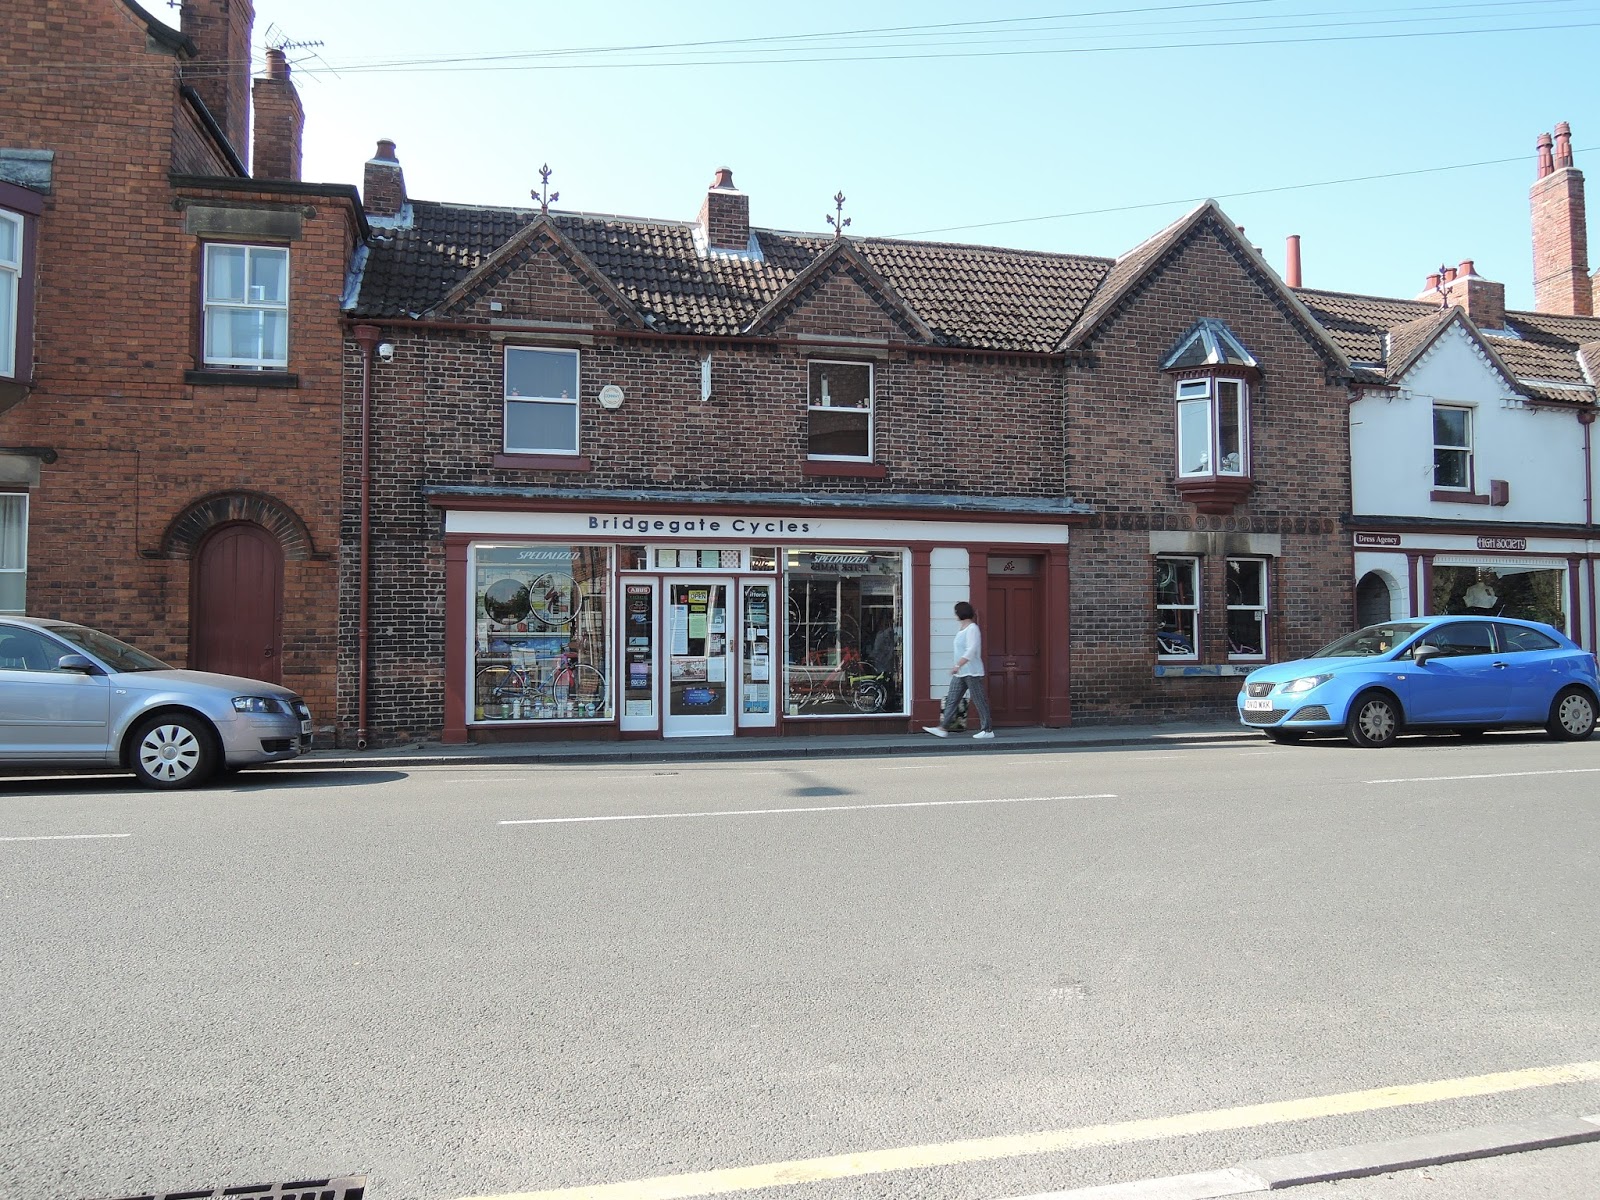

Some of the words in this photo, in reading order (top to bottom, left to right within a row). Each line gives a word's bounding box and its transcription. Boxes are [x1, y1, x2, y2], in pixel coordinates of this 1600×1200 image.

[588, 516, 721, 533] Bridgegate
[732, 519, 810, 535] Cycles
[1358, 535, 1376, 543] Dress
[1376, 536, 1398, 545] Agency
[517, 551, 580, 560] SPECIALIZED
[812, 555, 869, 563] SPECIALIZED
